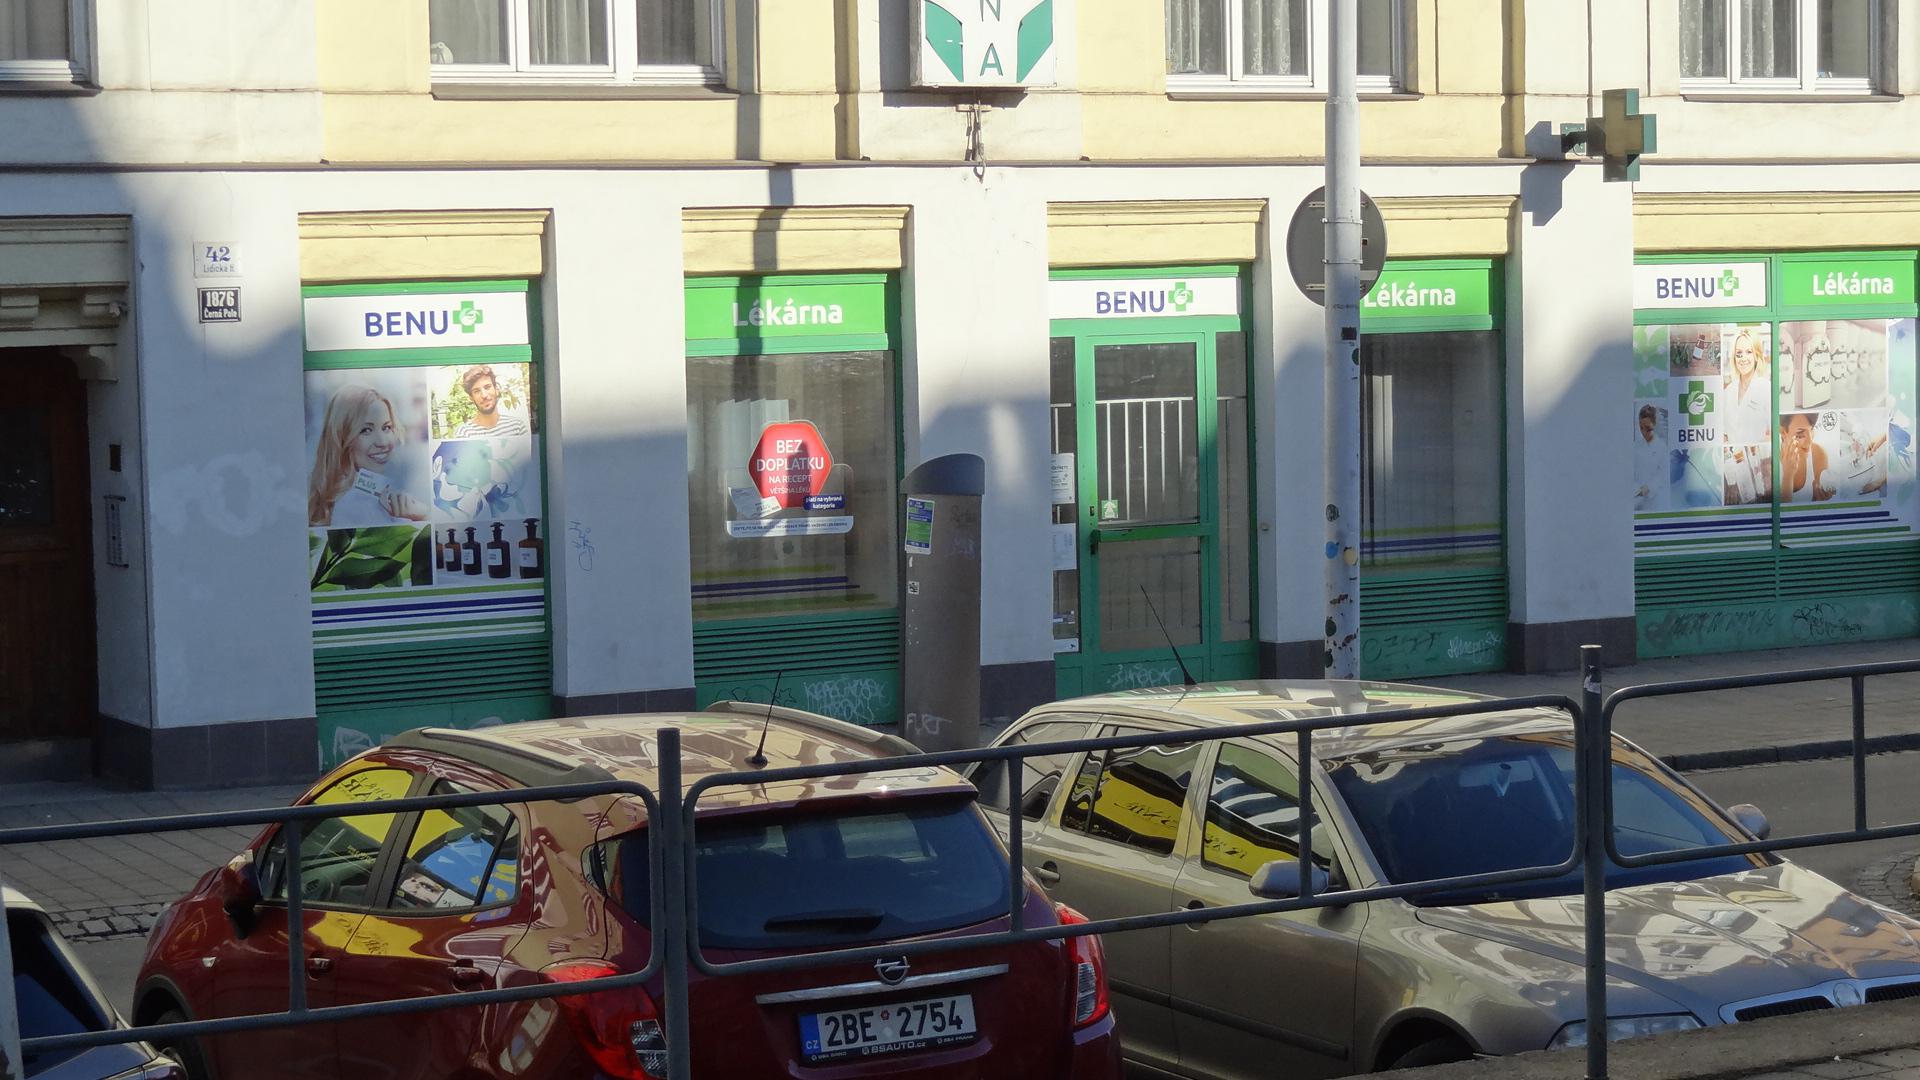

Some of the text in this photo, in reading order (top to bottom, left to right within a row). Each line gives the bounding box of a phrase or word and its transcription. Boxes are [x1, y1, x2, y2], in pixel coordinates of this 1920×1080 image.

[206, 246, 231, 262] 42
[1656, 277, 1715, 299] BENU
[1813, 272, 1894, 296] Lékárna
[206, 290, 235, 308] 1876
[1096, 290, 1165, 314] BENU
[1363, 281, 1456, 308] Lékárna
[204, 307, 238, 319] Černá Pole
[733, 298, 843, 327] Lékárna
[364, 310, 449, 337] BENU
[1678, 428, 1715, 443] BENU
[776, 439, 803, 454] BEZ
[756, 456, 825, 472] DOPLATKU
[768, 474, 813, 484] NA RECEPT
[824, 1000, 963, 1048] 2BE 2754
[806, 1039, 819, 1050] CZ
